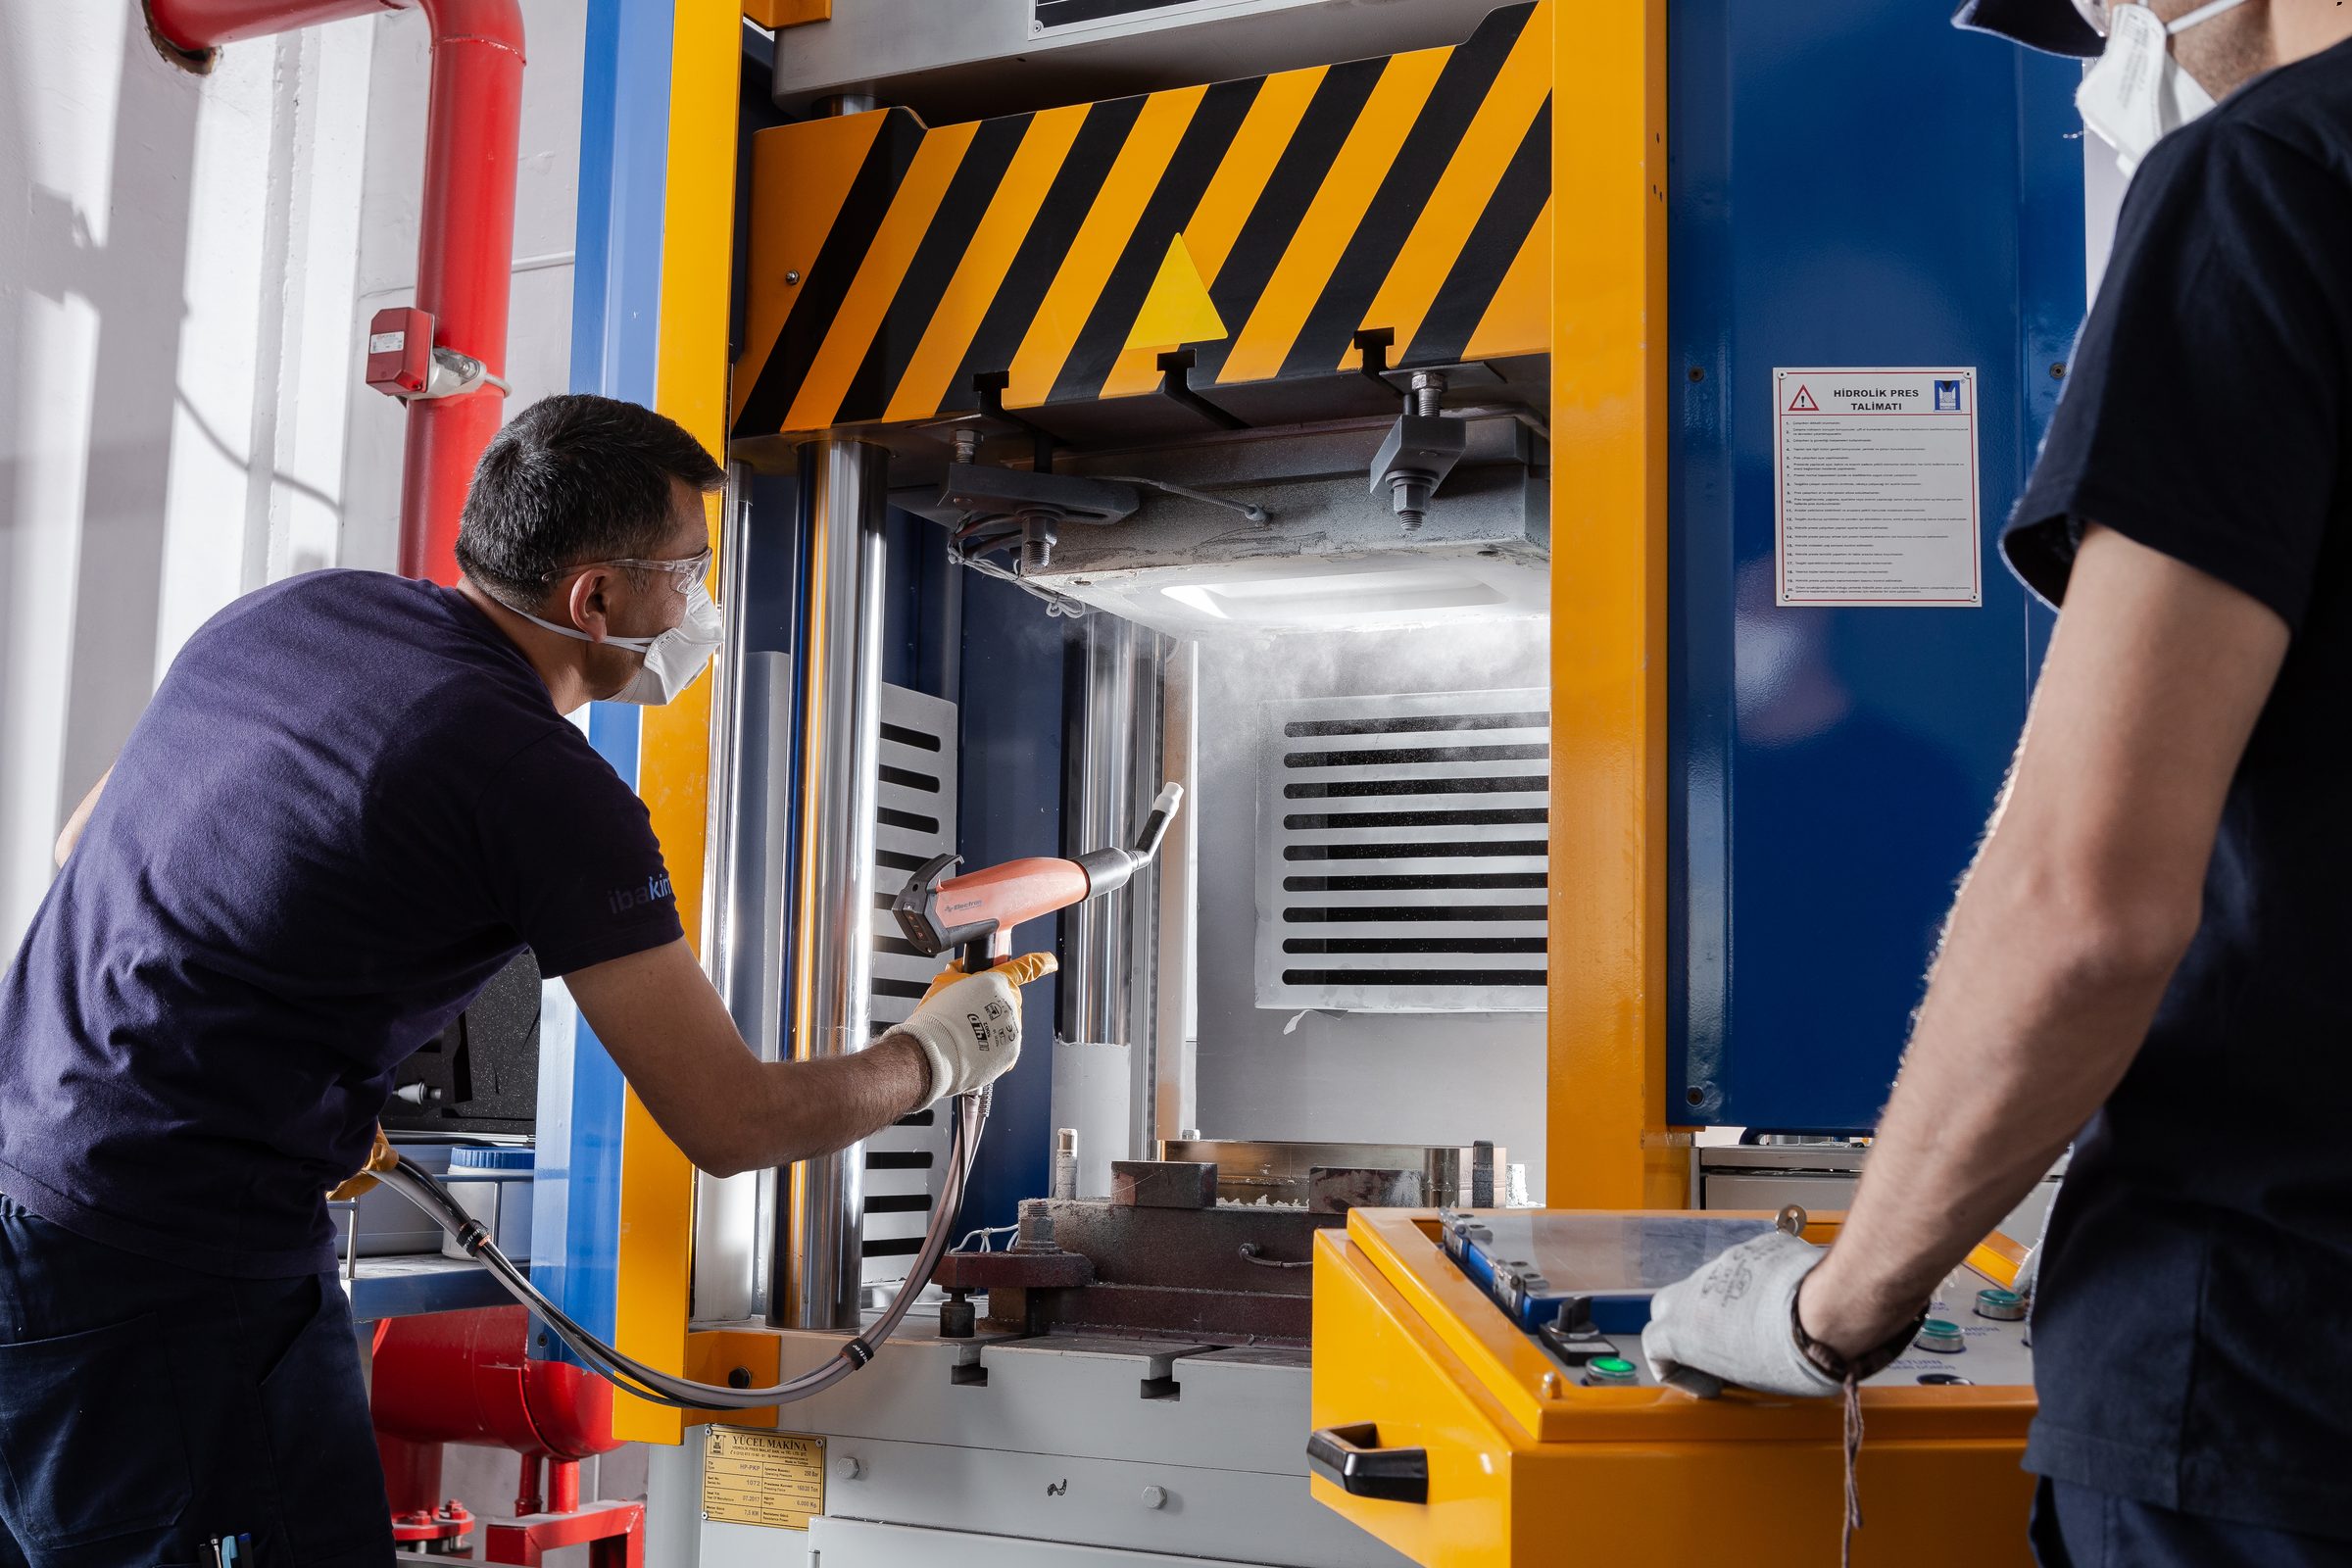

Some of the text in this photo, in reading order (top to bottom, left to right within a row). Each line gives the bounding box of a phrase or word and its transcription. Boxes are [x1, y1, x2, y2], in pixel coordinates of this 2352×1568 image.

[1834, 388, 1886, 397] HİDROLİK
[1851, 401, 1902, 411] TALİMATI
[733, 1435, 808, 1451] YÜCEL MAKİNA
